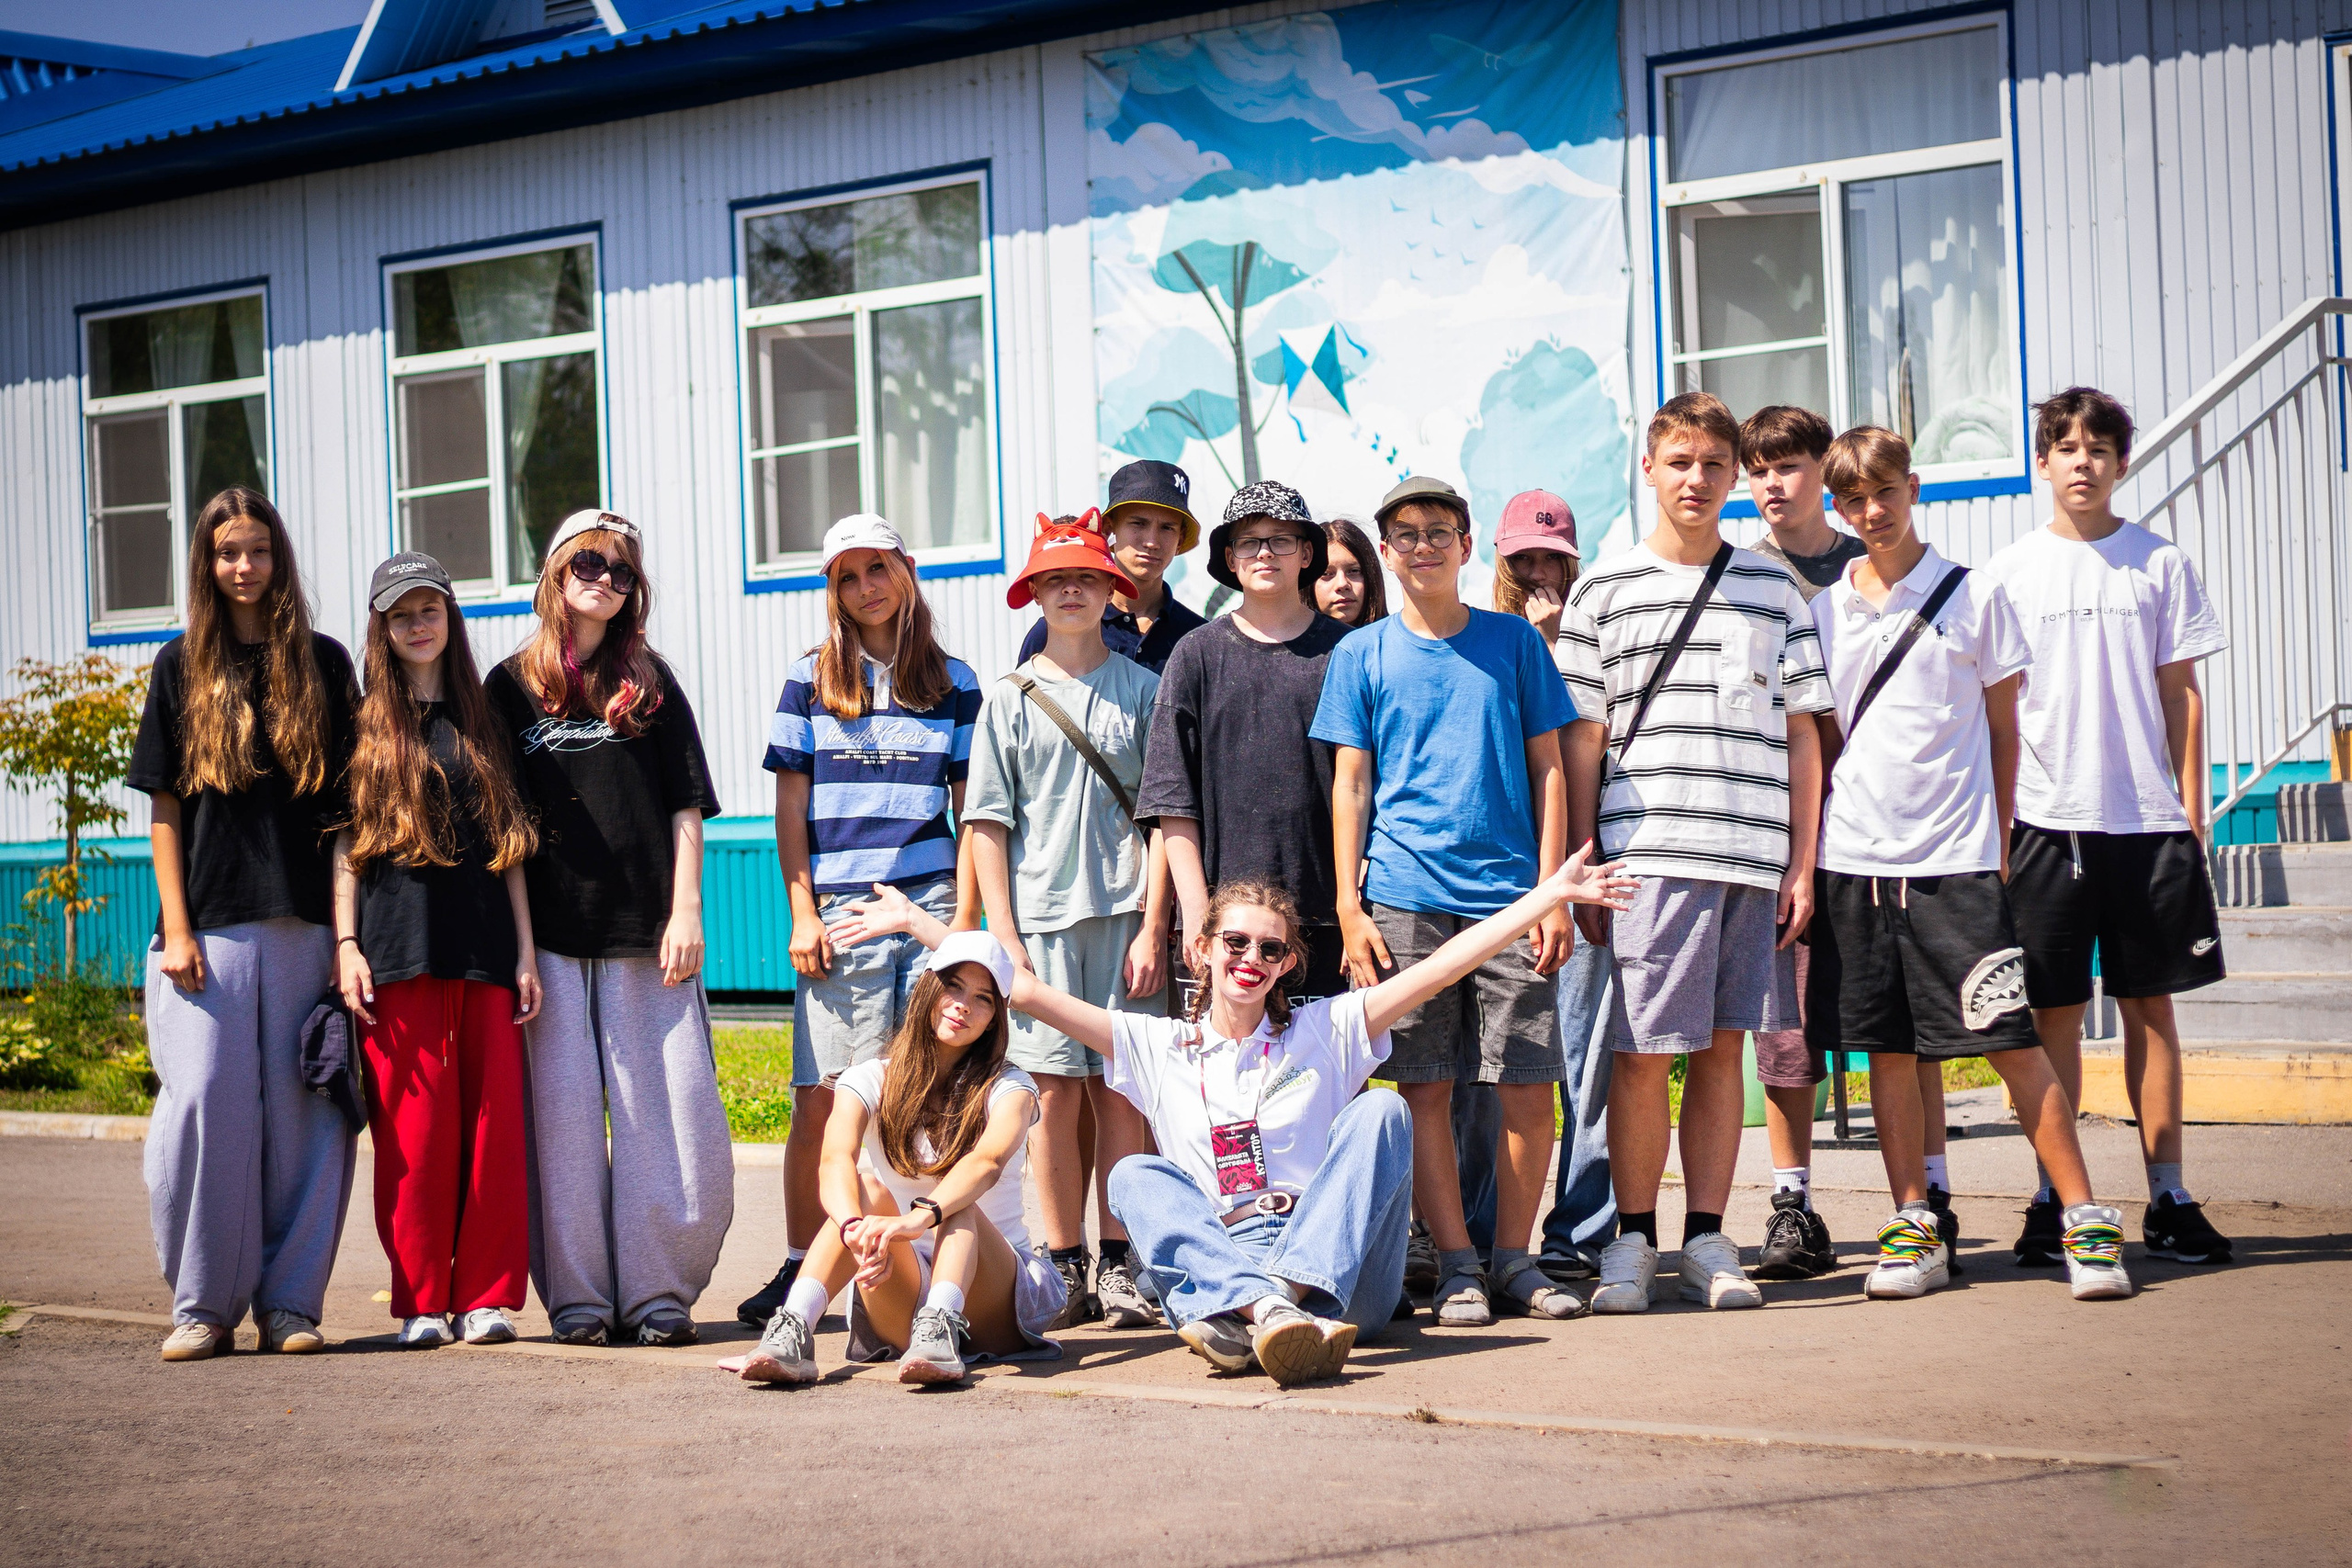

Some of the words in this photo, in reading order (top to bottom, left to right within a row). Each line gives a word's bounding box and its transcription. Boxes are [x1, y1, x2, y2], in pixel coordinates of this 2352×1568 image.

[389, 562, 428, 575] SELFCARE
[2041, 609, 2079, 624] TOMMY
[815, 721, 880, 750] Amalfi
[879, 721, 935, 746] Coast
[2197, 937, 2211, 949] NIKE
[1250, 1133, 1266, 1176] КУРАТОР
